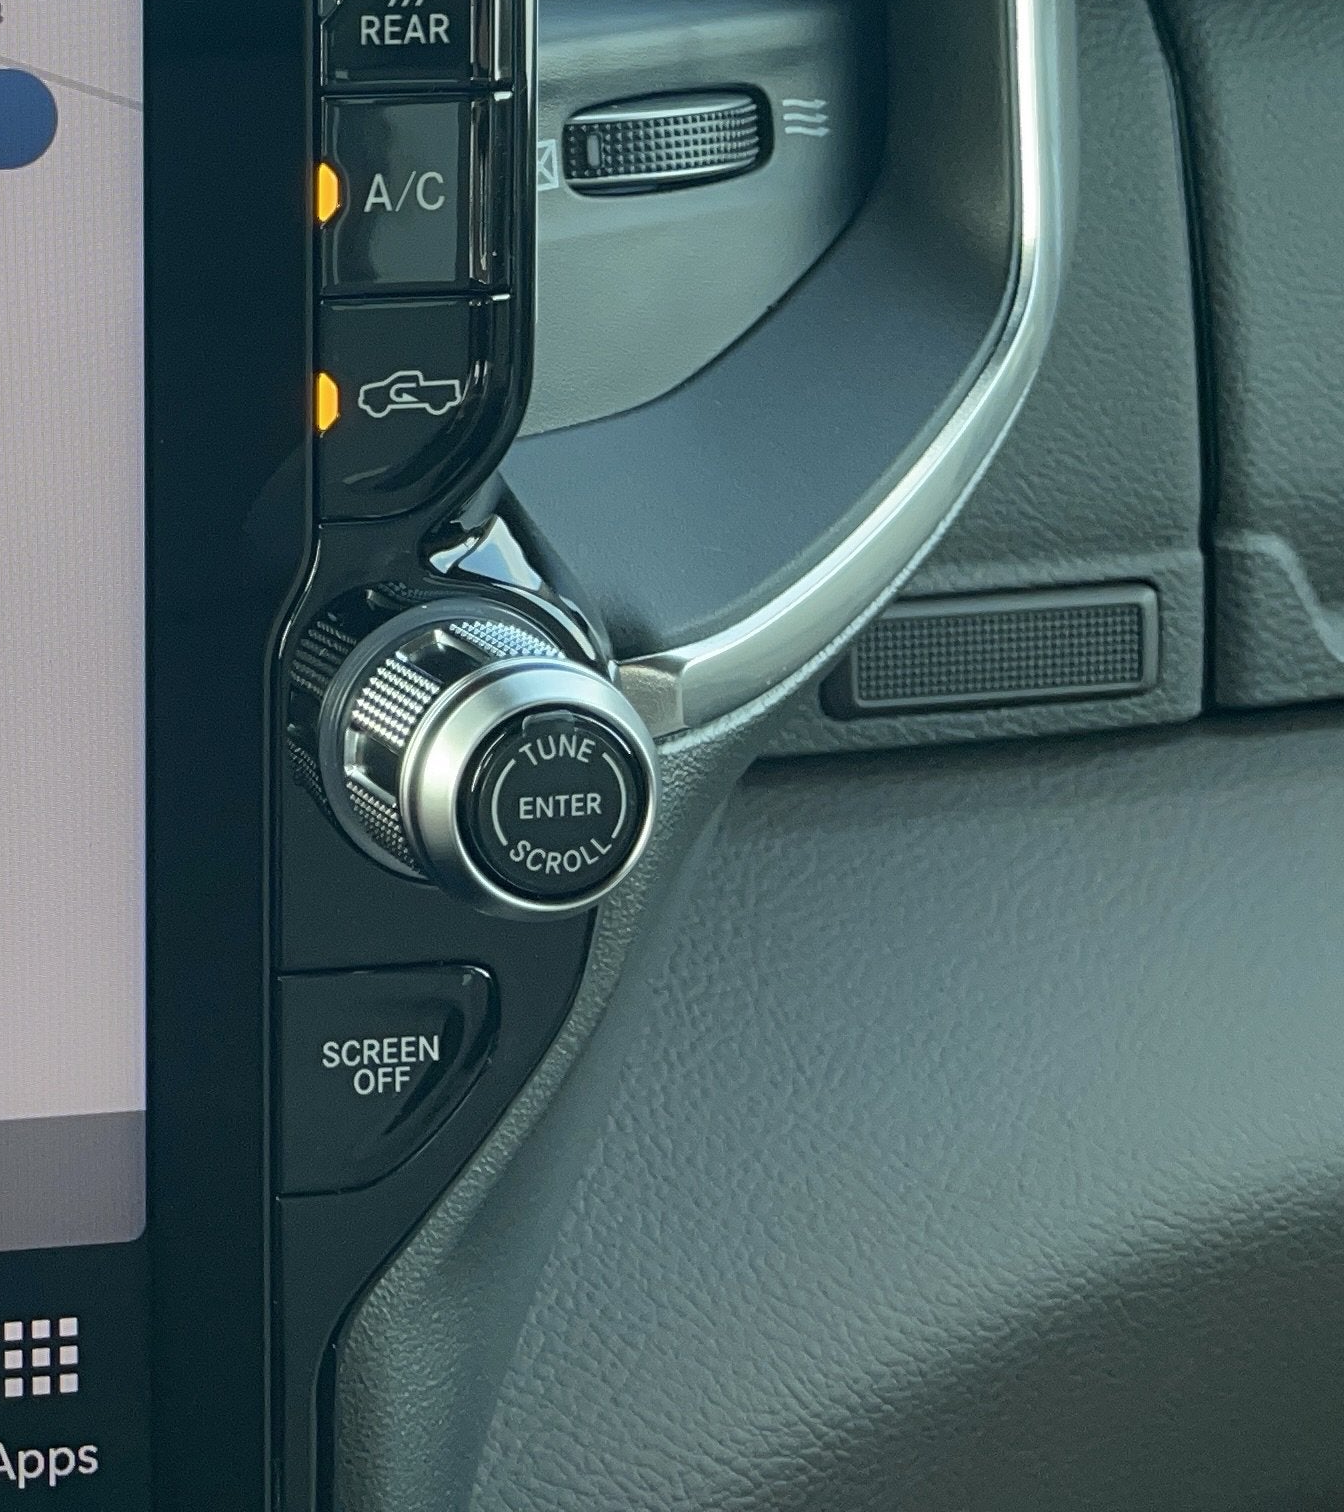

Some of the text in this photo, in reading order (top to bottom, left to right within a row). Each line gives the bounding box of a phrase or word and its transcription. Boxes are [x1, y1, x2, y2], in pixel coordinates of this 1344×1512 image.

[360, 13, 450, 46] REAR
[363, 171, 446, 213] A/C
[518, 734, 596, 765] TUNE
[519, 793, 602, 819] ENTER
[509, 838, 612, 875] SCROLL
[322, 1035, 440, 1069] SCREEN
[353, 1066, 411, 1095] OFF
